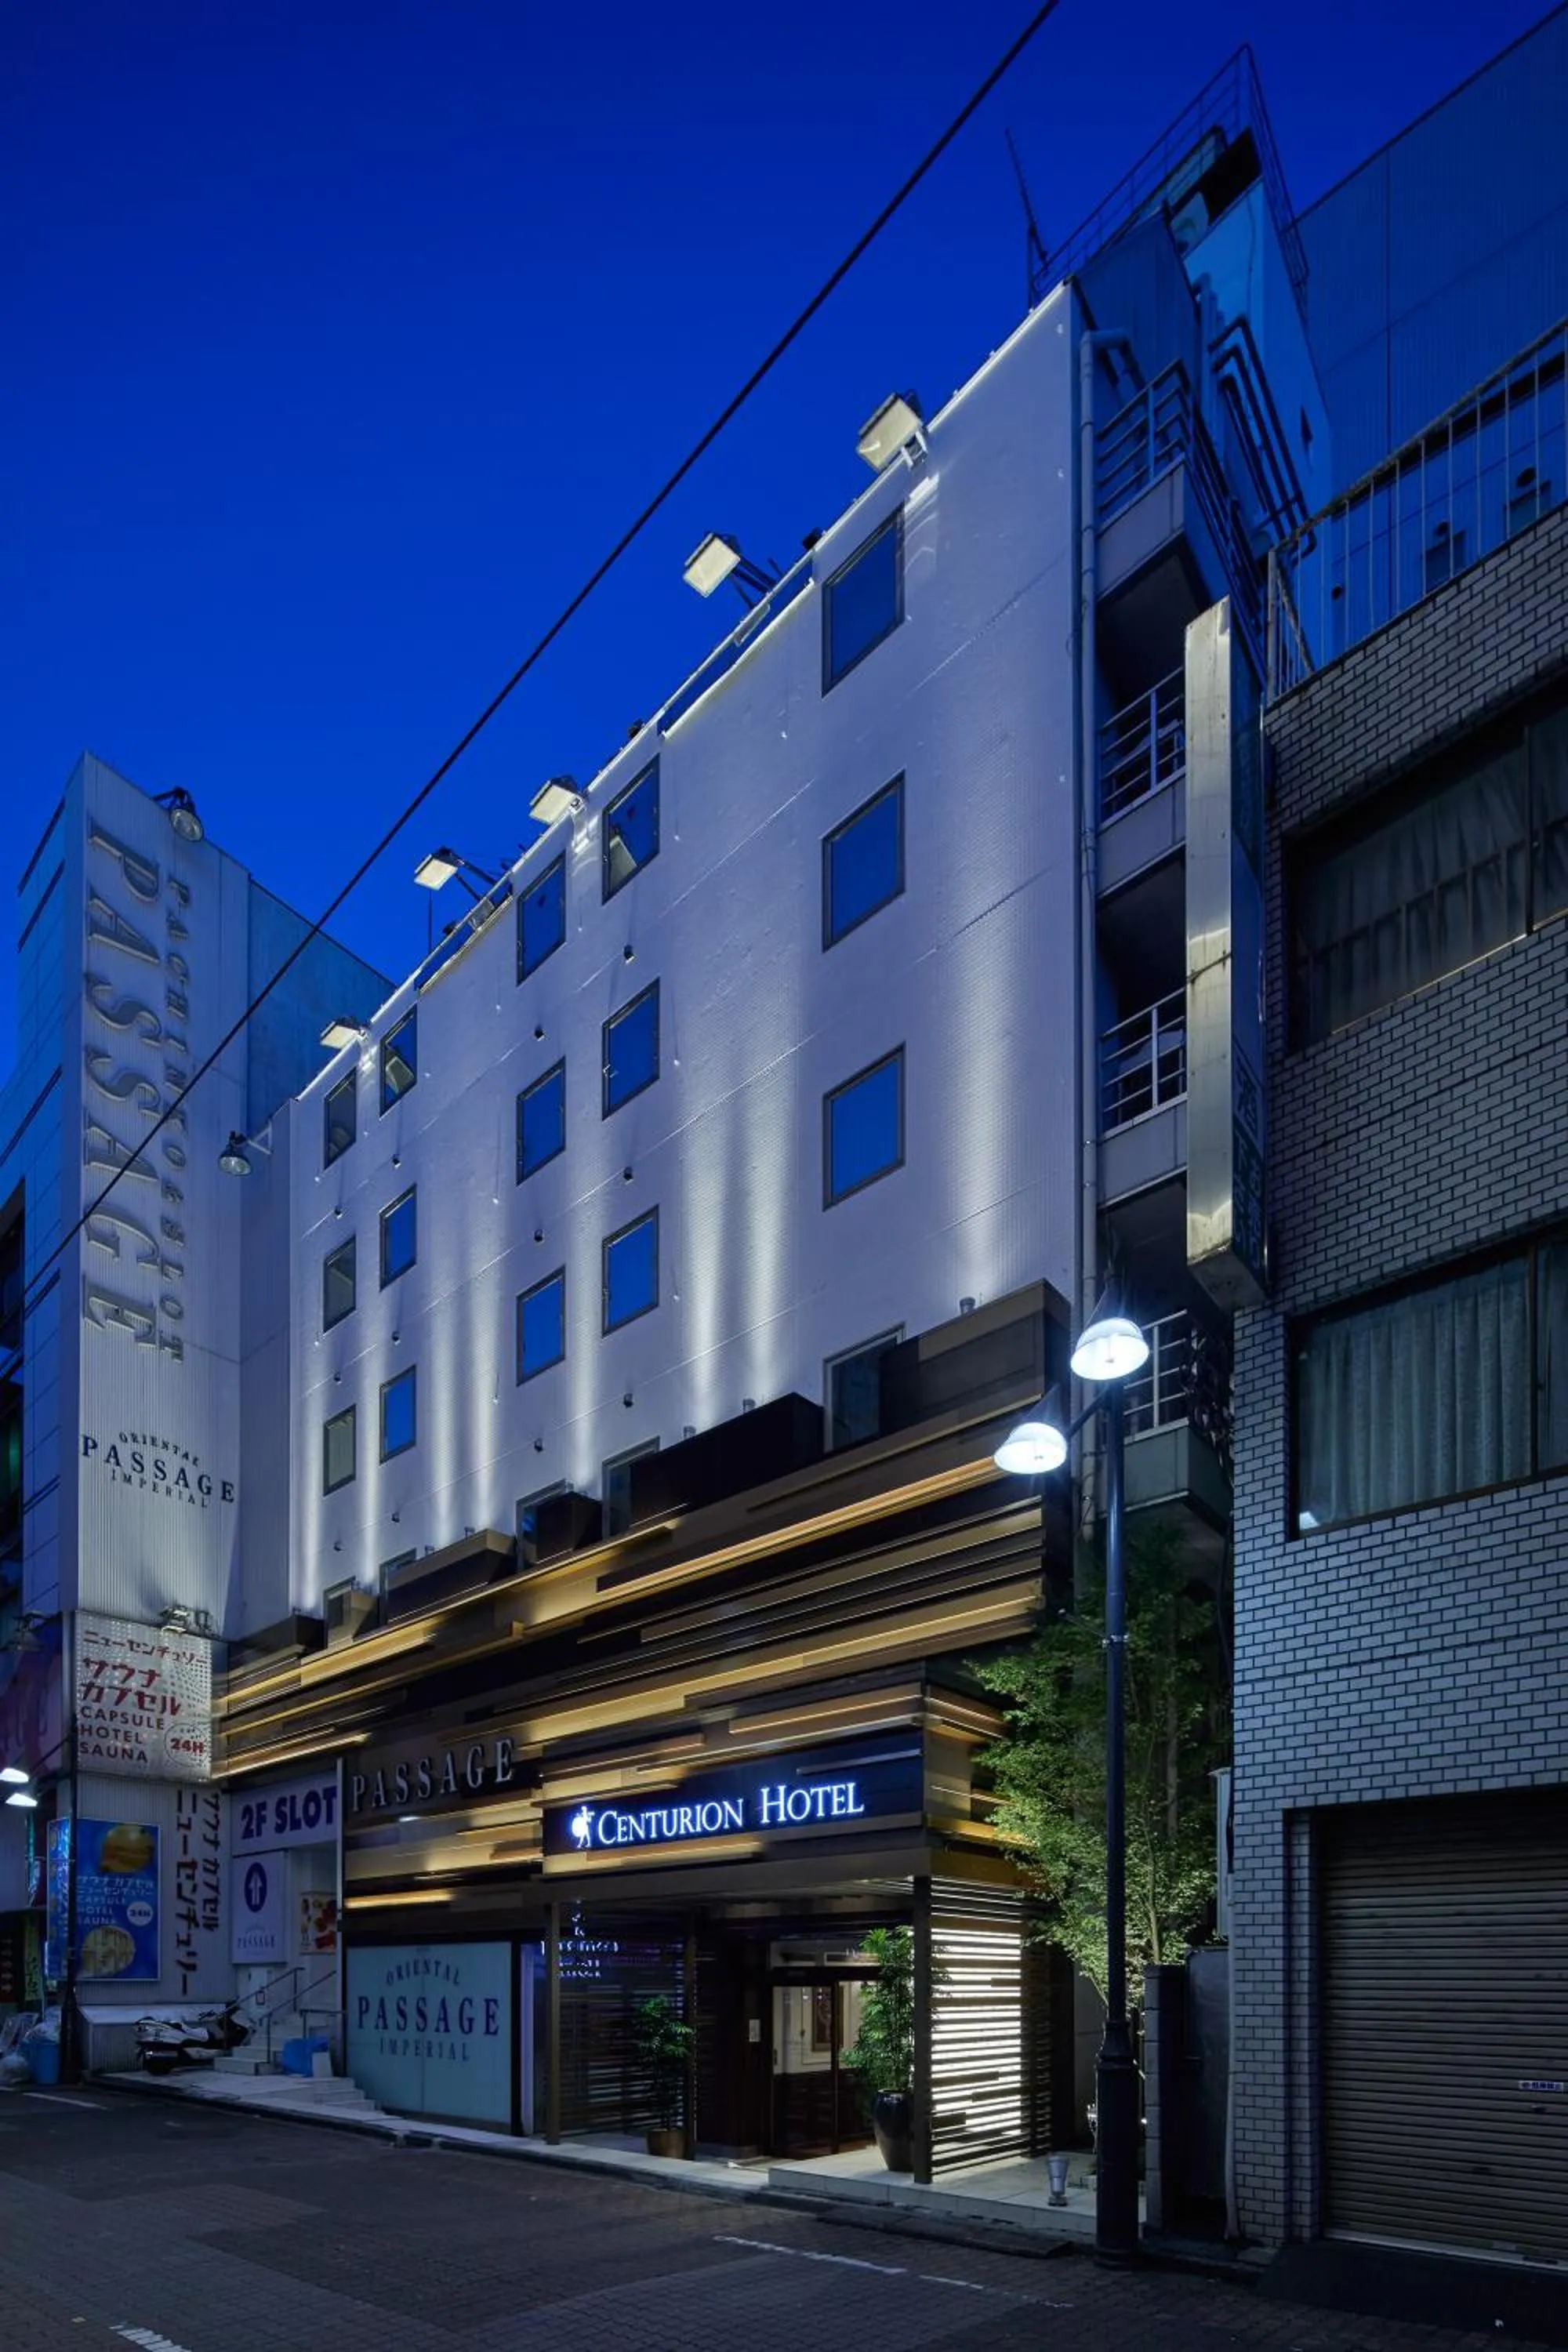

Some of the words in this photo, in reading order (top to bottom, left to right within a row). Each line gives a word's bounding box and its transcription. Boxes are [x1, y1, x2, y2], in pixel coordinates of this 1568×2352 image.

[84, 816, 162, 1352] PASSAGE
[119, 1432, 200, 1467] ORIENTAL
[82, 1436, 235, 1504] PASSAGE
[111, 1469, 209, 1508] IMPERIAL
[82, 1630, 207, 1664] ニューセンチュリー
[82, 1657, 161, 1688] サウナ
[79, 1723, 143, 1744] HOTEL
[81, 1705, 164, 1730] CAPSULE
[79, 1741, 148, 1763] SAUNA
[170, 1737, 205, 1755] 24H
[352, 1738, 514, 1813] PASSAGE
[241, 1801, 267, 1840] 2F
[274, 1785, 337, 1834] SLOT
[598, 1798, 744, 1845] CENTURION
[761, 1781, 866, 1824] HOTEL
[174, 1790, 200, 1996] ニューセンチュリー
[385, 1957, 460, 1987] ORIENTAL
[358, 1995, 500, 2036] PASSAGE
[379, 2037, 470, 2062] IMPERIAL
